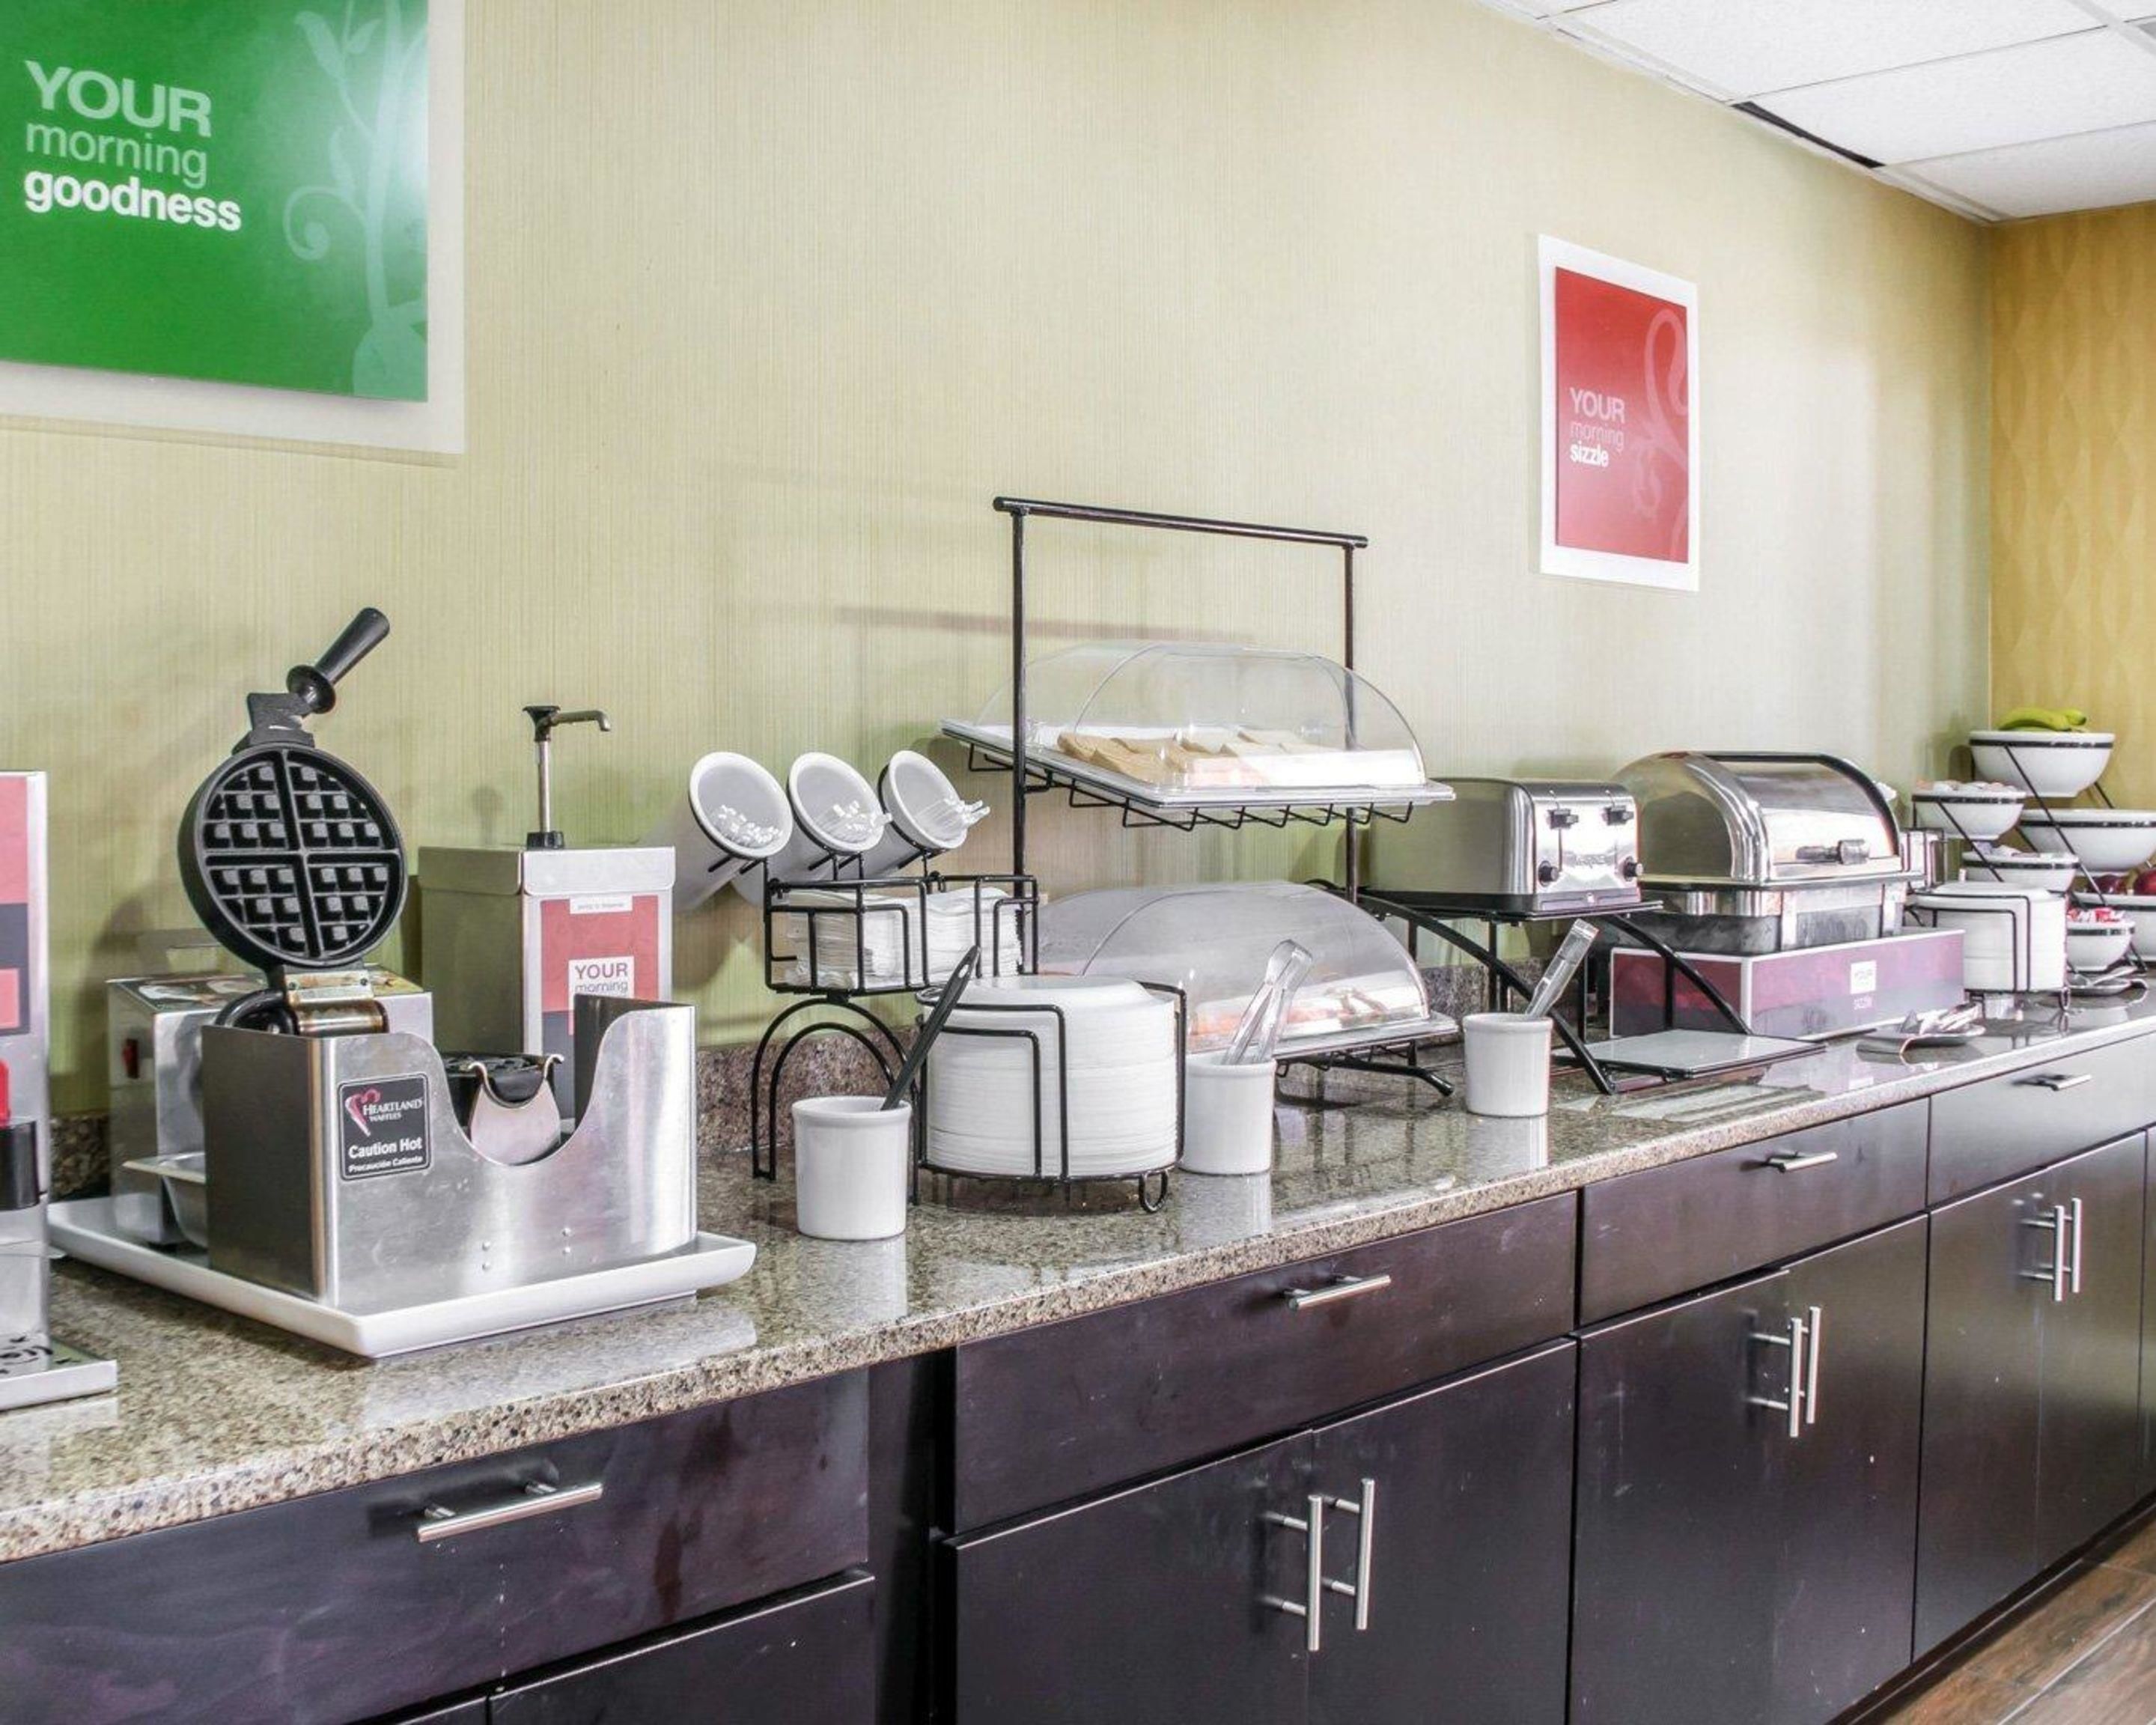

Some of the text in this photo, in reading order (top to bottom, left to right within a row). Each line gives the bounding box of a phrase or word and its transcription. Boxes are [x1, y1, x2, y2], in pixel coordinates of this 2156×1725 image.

[25, 60, 212, 137] YOUR
[26, 122, 207, 189] morning
[24, 170, 242, 231] goodness
[1570, 387, 1625, 425] YOUR
[1570, 440, 1609, 467] sizzle
[1571, 422, 1624, 456] morning
[574, 963, 628, 979] YOUR
[575, 981, 628, 994] morning
[363, 1098, 423, 1116] HEARTLAND
[348, 1137, 422, 1158] Caution Hot
